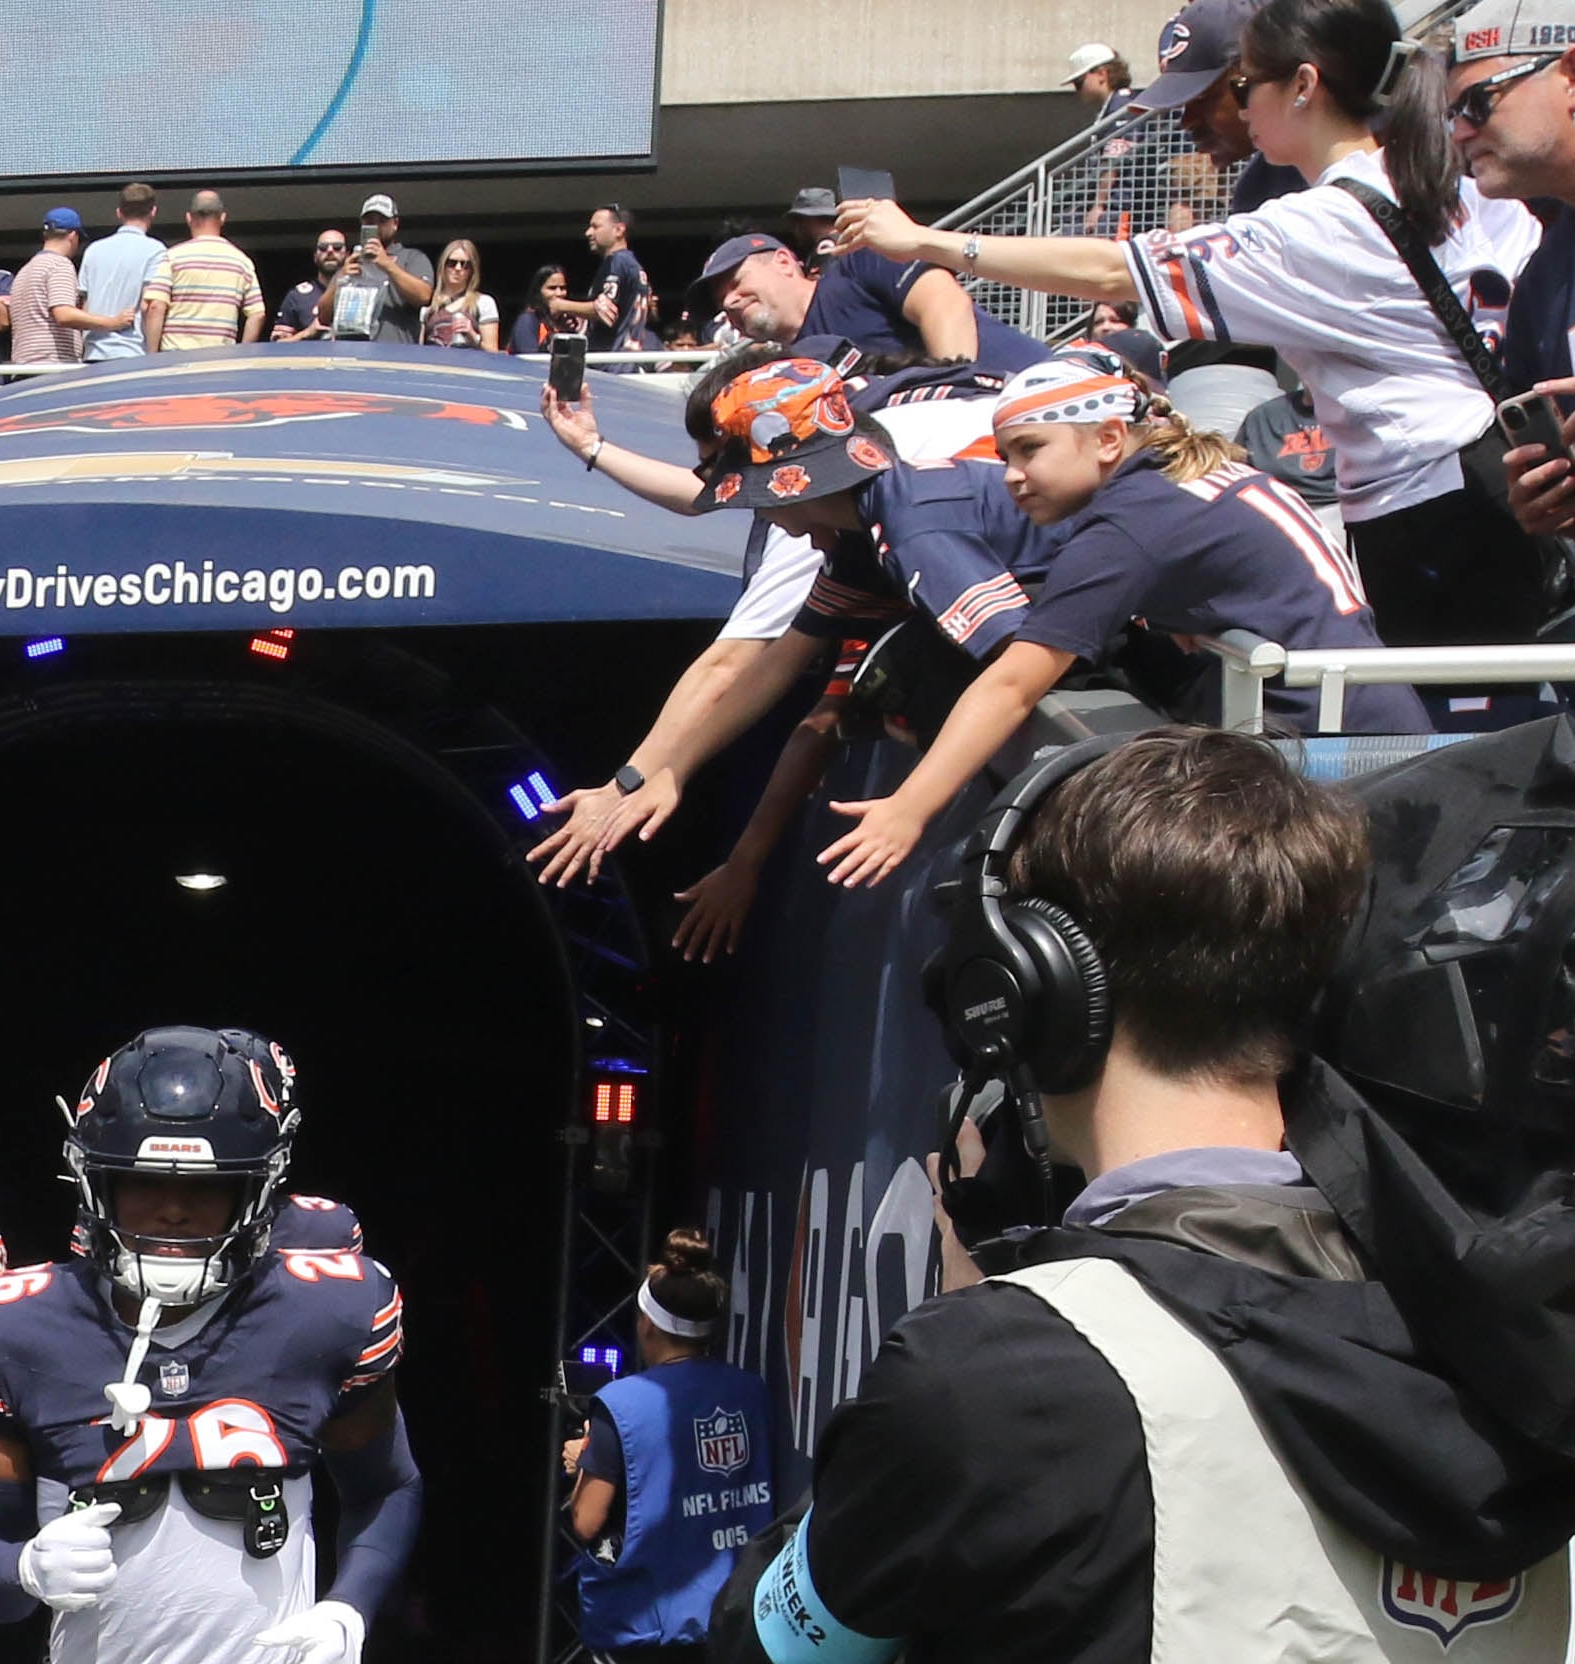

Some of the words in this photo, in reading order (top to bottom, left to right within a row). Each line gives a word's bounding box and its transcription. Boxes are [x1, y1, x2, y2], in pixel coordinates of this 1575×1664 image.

[964, 996, 1006, 1021] SHURE
[150, 1142, 202, 1153] BEARS
[704, 1436, 745, 1466] NFL
[683, 1490, 718, 1518] NFL
[720, 1481, 771, 1509] FILMS
[712, 1524, 749, 1551] 005
